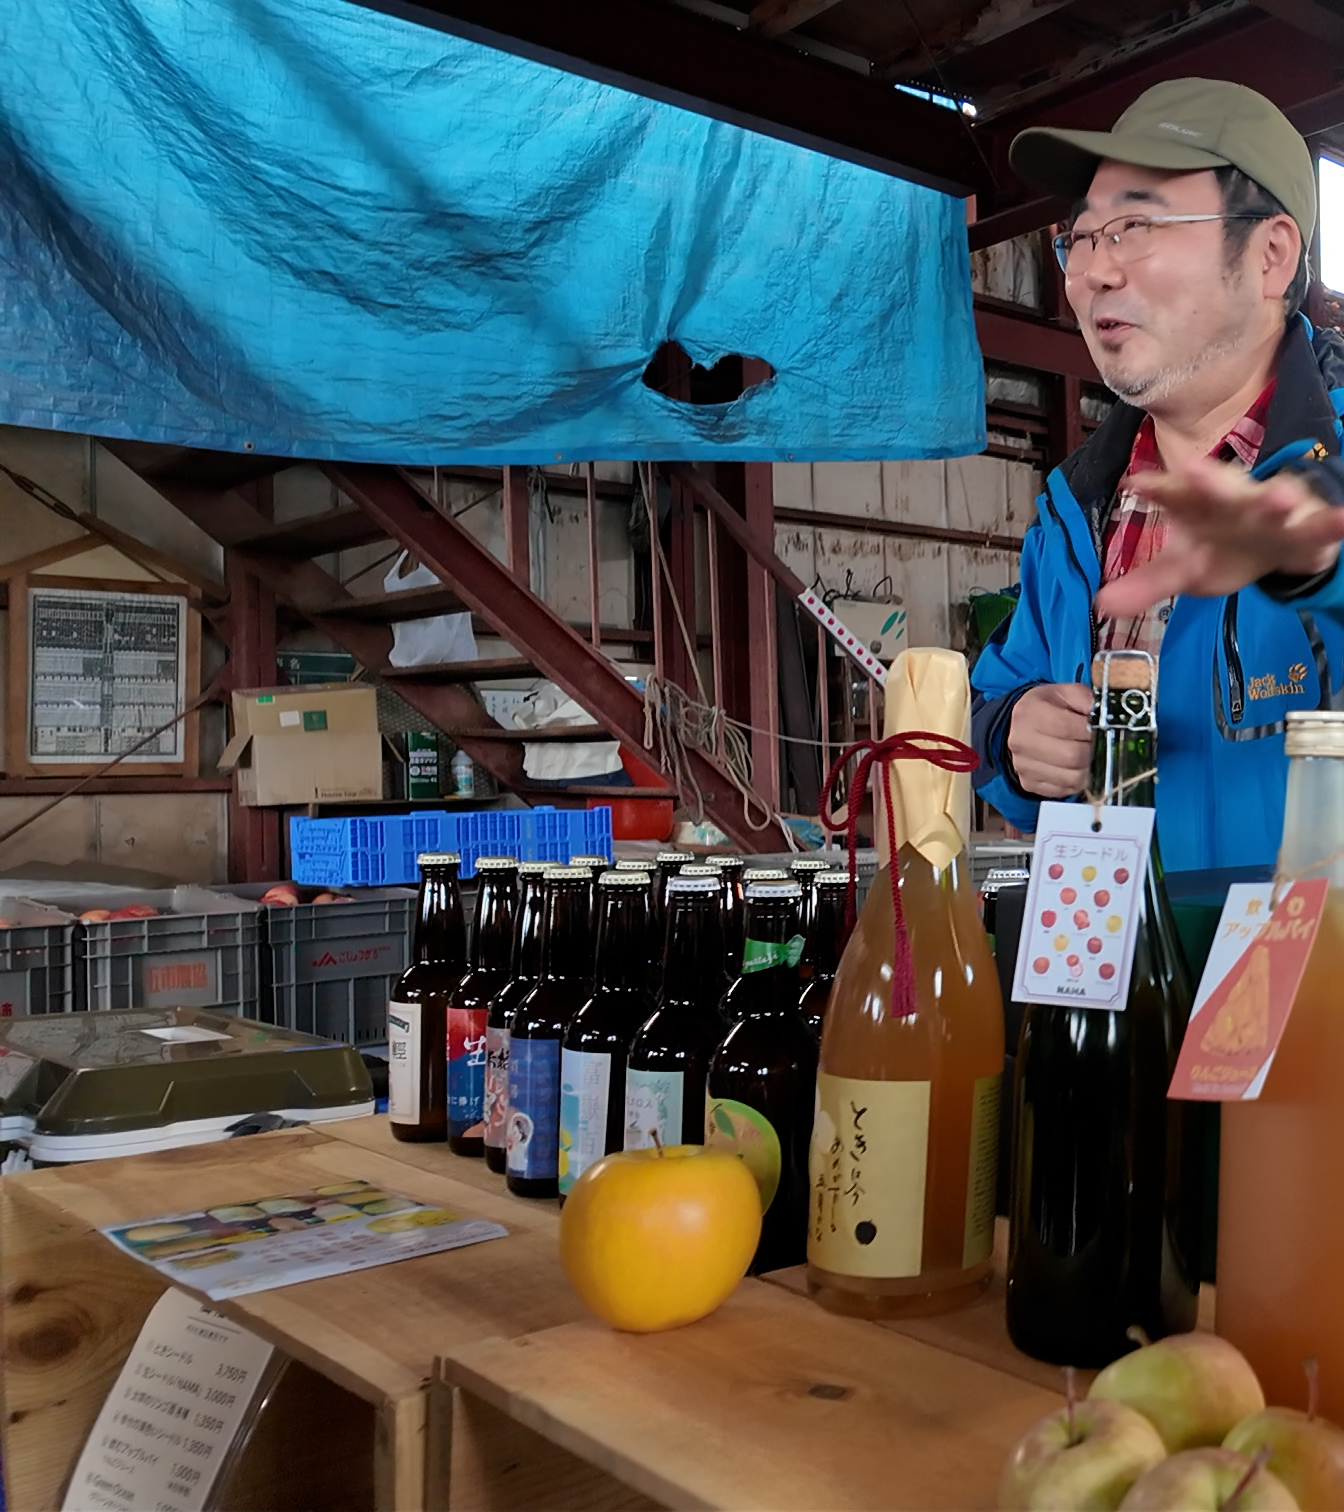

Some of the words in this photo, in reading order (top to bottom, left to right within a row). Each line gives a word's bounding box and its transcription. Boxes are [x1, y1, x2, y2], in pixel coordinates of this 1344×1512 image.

[1248, 673, 1276, 689] Jack
[1248, 682, 1305, 700] Wolfskin
[1054, 844, 1128, 862] 生シードル
[1056, 986, 1086, 997] NAMA
[214, 1362, 247, 1384] 3,750円
[203, 1386, 236, 1408] 3,000円
[169, 1462, 201, 1485] 1,000円
